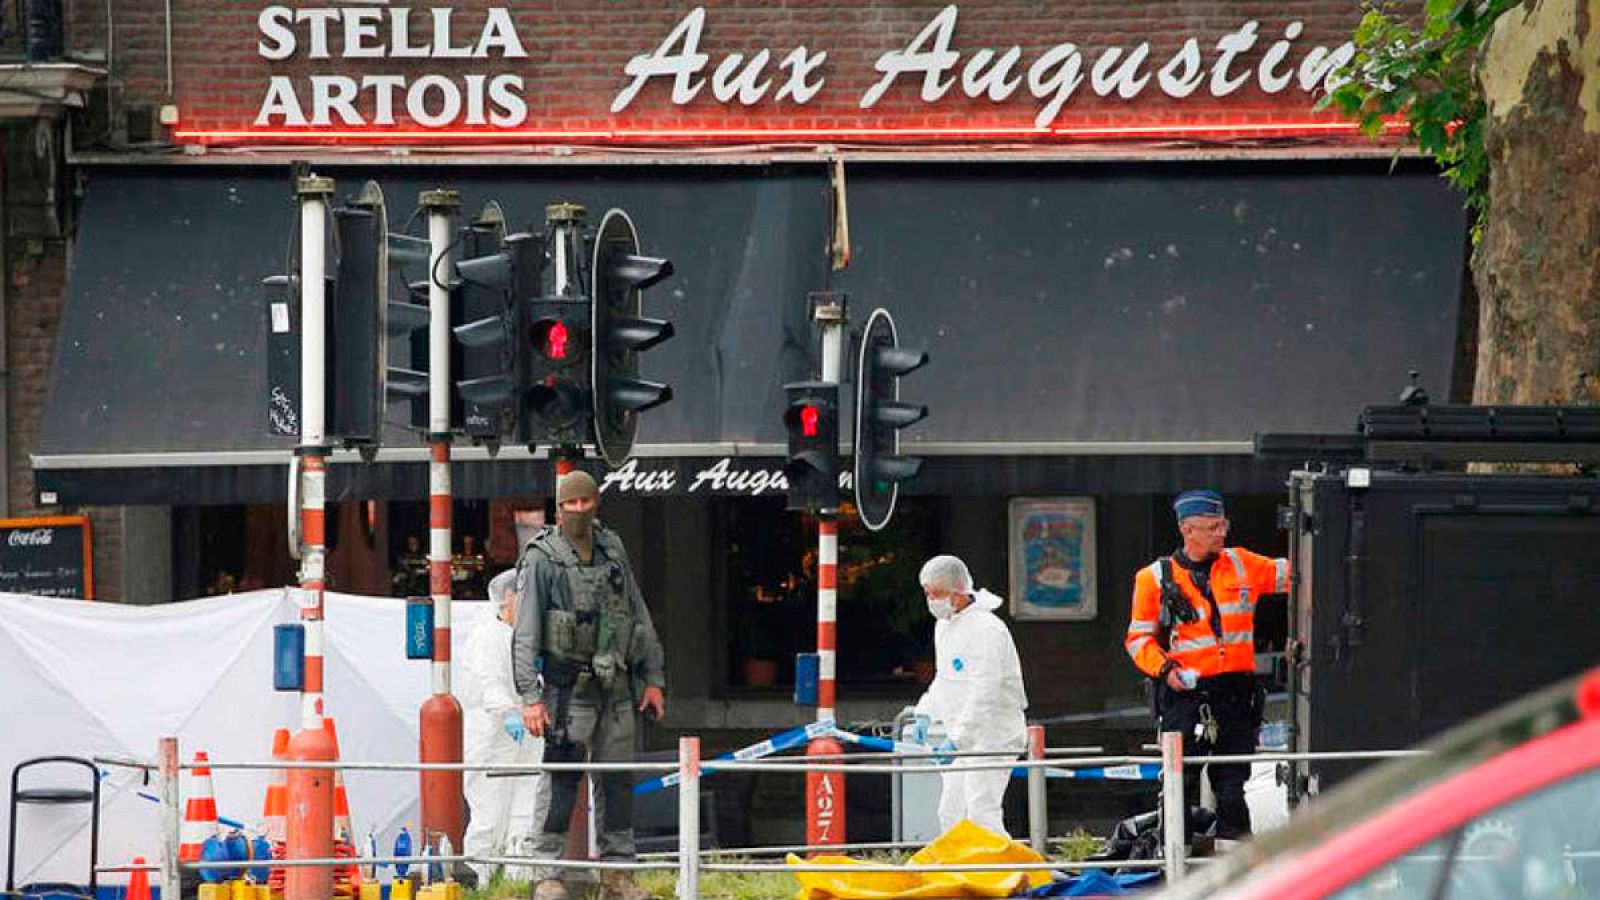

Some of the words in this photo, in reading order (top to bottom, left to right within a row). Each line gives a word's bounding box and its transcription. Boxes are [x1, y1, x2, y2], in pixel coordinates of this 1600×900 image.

[257, 6, 528, 59] STELLA
[610, 7, 827, 113] Aux
[254, 74, 528, 128] ARTOIS
[598, 458, 677, 492] Aux
